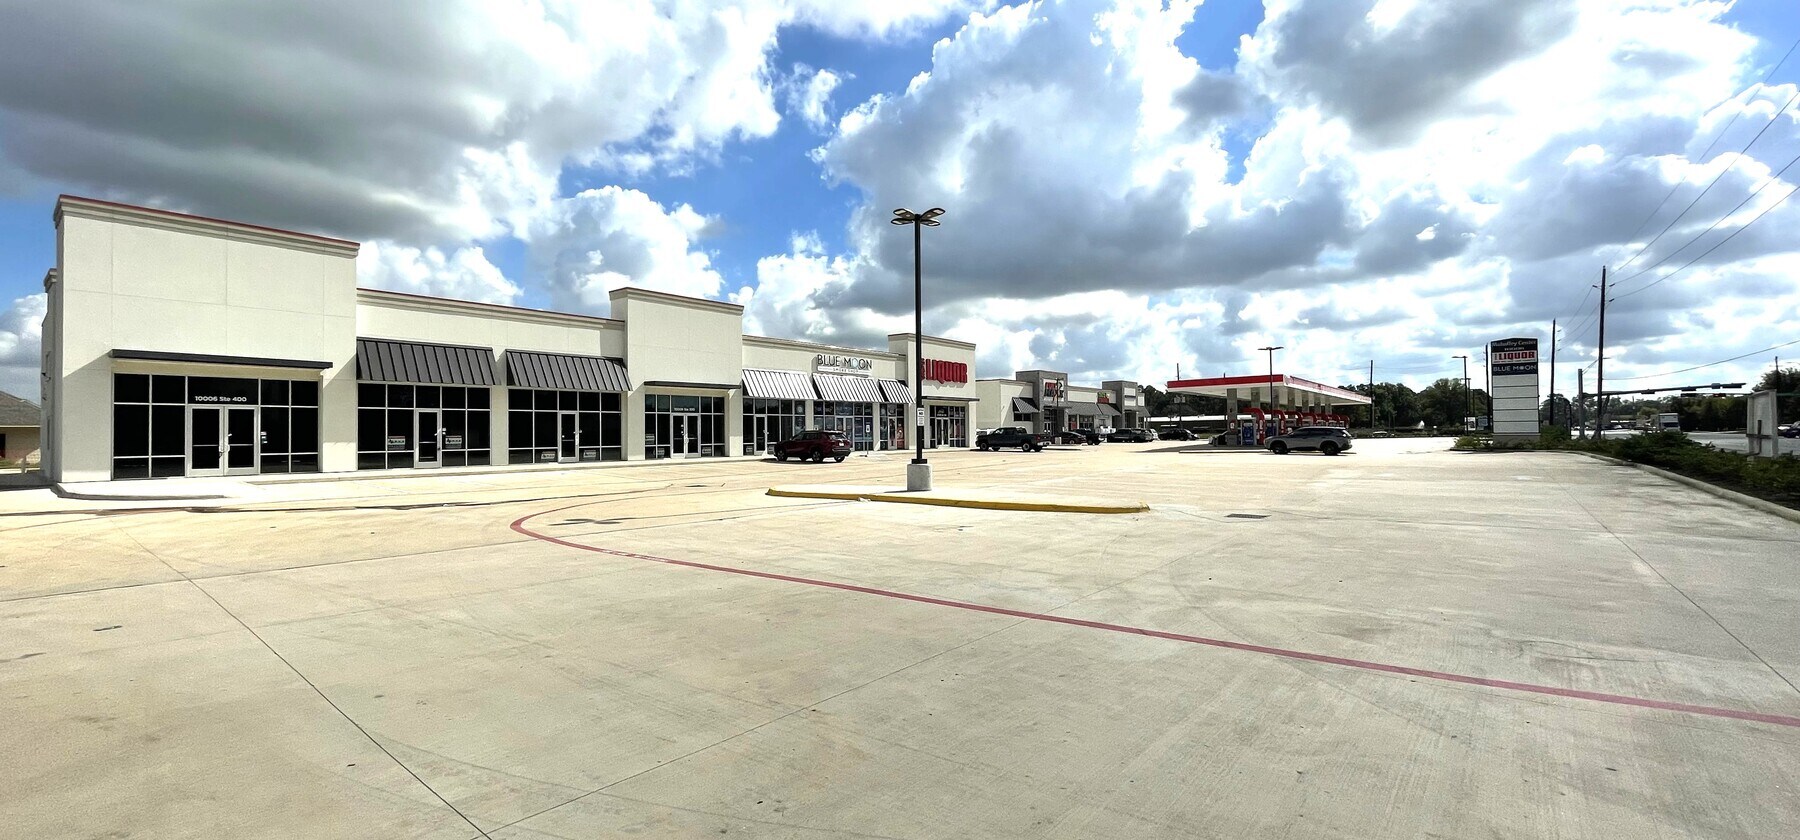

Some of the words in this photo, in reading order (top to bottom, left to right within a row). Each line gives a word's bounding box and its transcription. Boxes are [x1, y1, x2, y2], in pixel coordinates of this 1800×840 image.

[817, 354, 840, 367] BLUE
[843, 357, 872, 370] MOON
[1499, 351, 1535, 360] LIQUOR
[926, 359, 967, 384] LIQUOR
